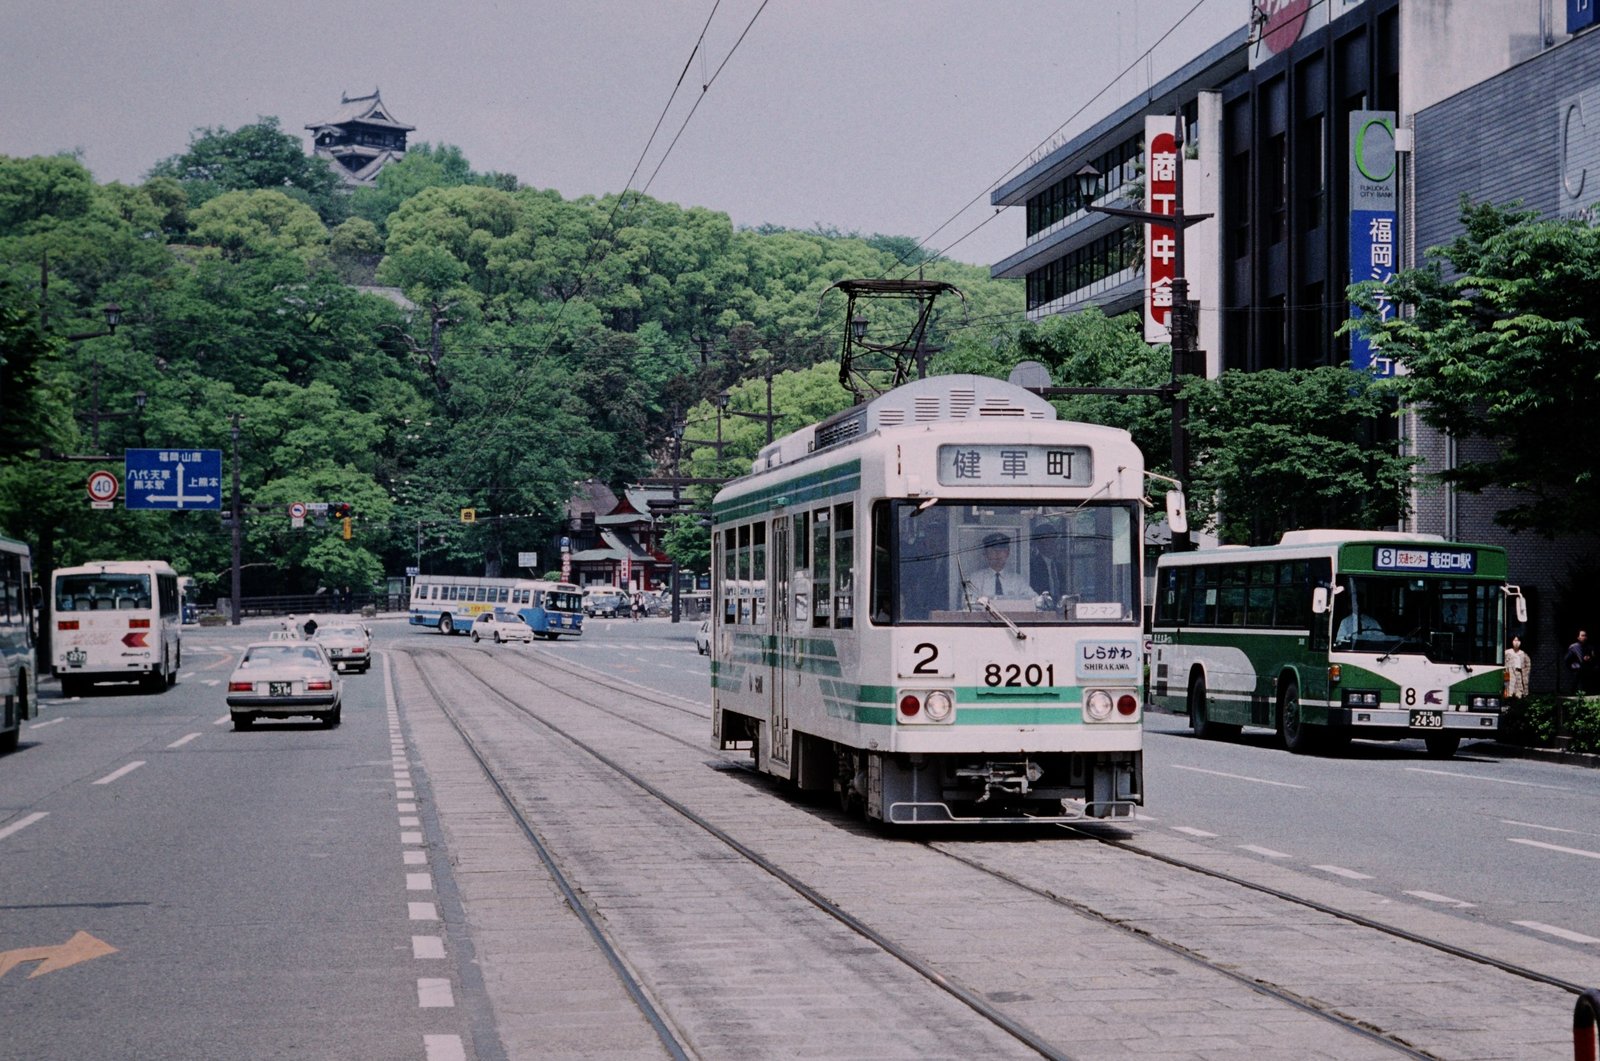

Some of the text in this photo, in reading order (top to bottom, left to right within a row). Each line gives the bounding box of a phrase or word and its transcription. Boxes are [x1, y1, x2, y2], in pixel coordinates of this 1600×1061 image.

[1369, 218, 1393, 375] 福岡シティ行
[952, 449, 1075, 480] 健軍町
[94, 480, 111, 494] 40
[133, 480, 165, 490] 熊本駅
[187, 477, 219, 488] 上熊本
[1381, 549, 1392, 566] 8
[1430, 551, 1472, 569] 竜田口駅
[1079, 605, 1117, 616] ワンマン
[912, 642, 940, 675] 2
[1083, 646, 1133, 660] しらかわ
[1084, 663, 1130, 671] SHIRAKAWA
[984, 663, 1054, 687] 8201
[1405, 686, 1416, 706] 8
[1415, 715, 1441, 727] 24-90
